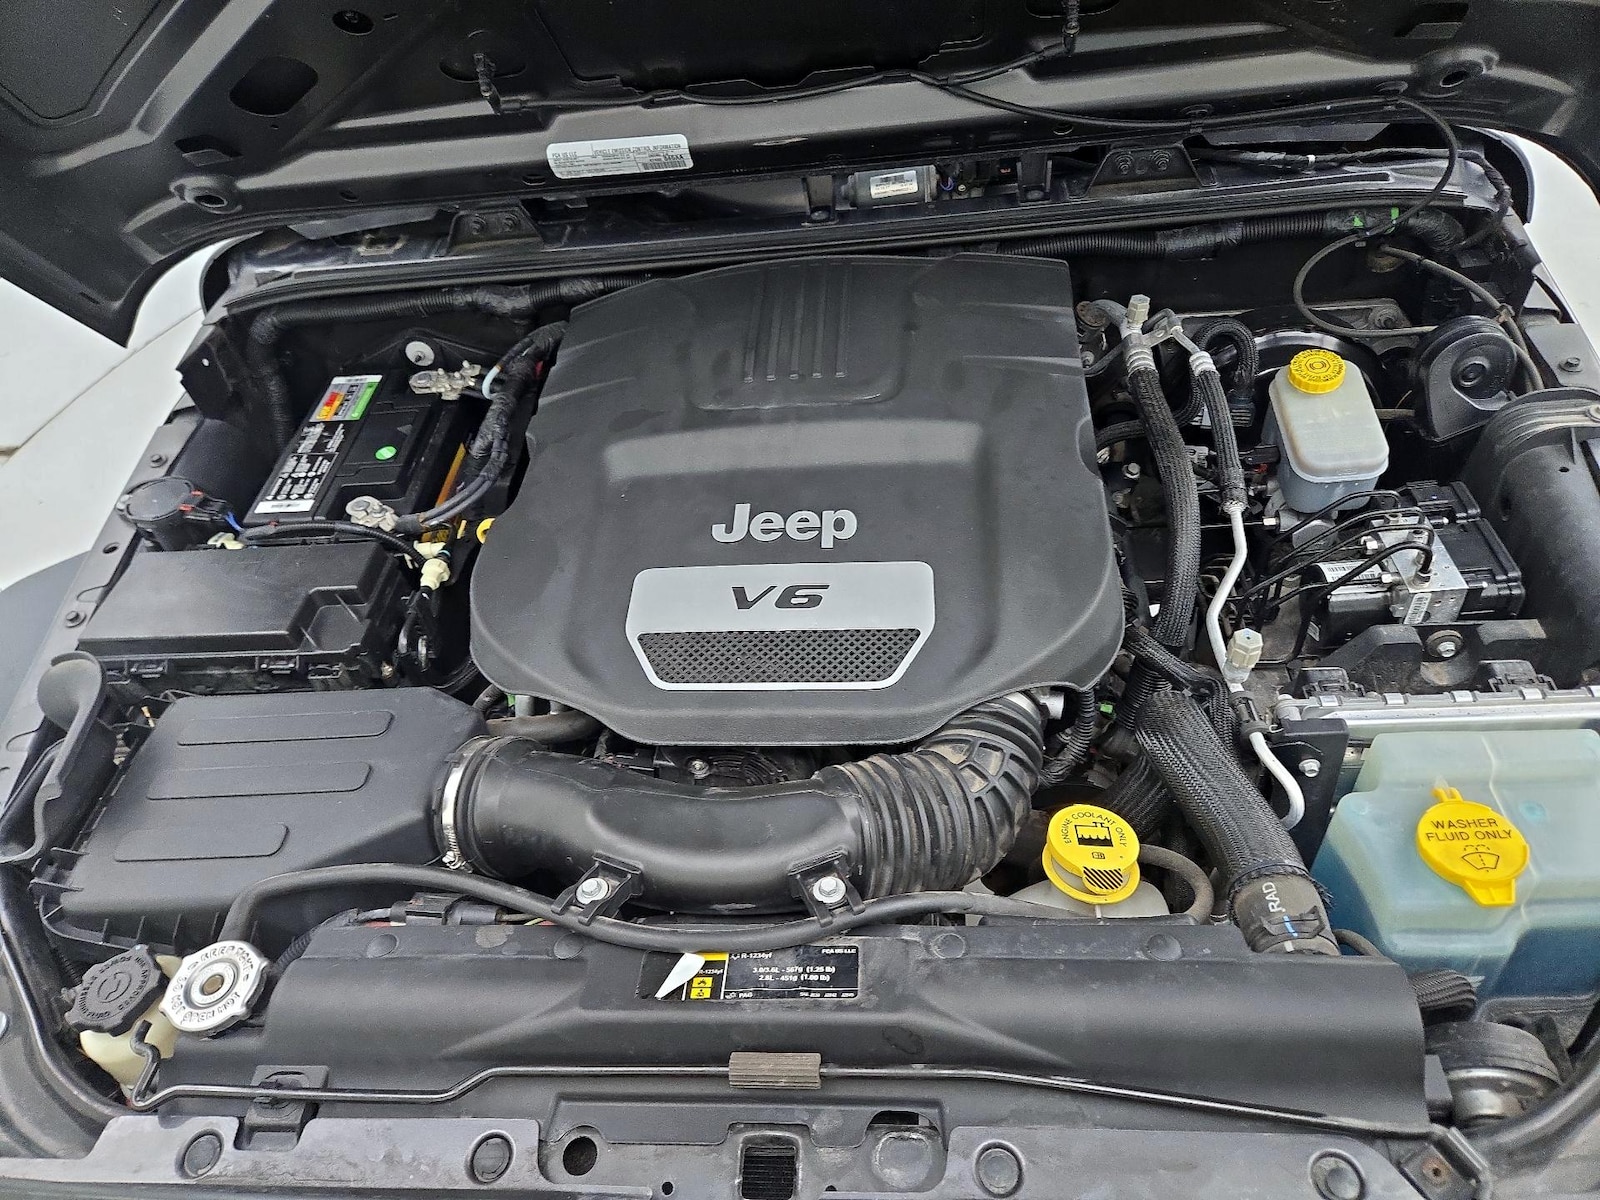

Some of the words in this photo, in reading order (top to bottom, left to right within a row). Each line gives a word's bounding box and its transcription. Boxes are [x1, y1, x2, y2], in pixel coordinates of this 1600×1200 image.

[711, 503, 858, 549] Jeep
[731, 584, 831, 610] V6
[1061, 818, 1073, 844] ENGINE
[1071, 811, 1116, 826] COOLANT
[1115, 827, 1128, 848] ONLY
[1431, 817, 1498, 829] WASHER
[1425, 831, 1470, 842] FLUID
[1474, 829, 1512, 840] ONLY
[1262, 881, 1286, 913] RAD
[741, 952, 772, 960] R-1234yf
[825, 965, 836, 974] lb)
[819, 974, 830, 983] lb)
